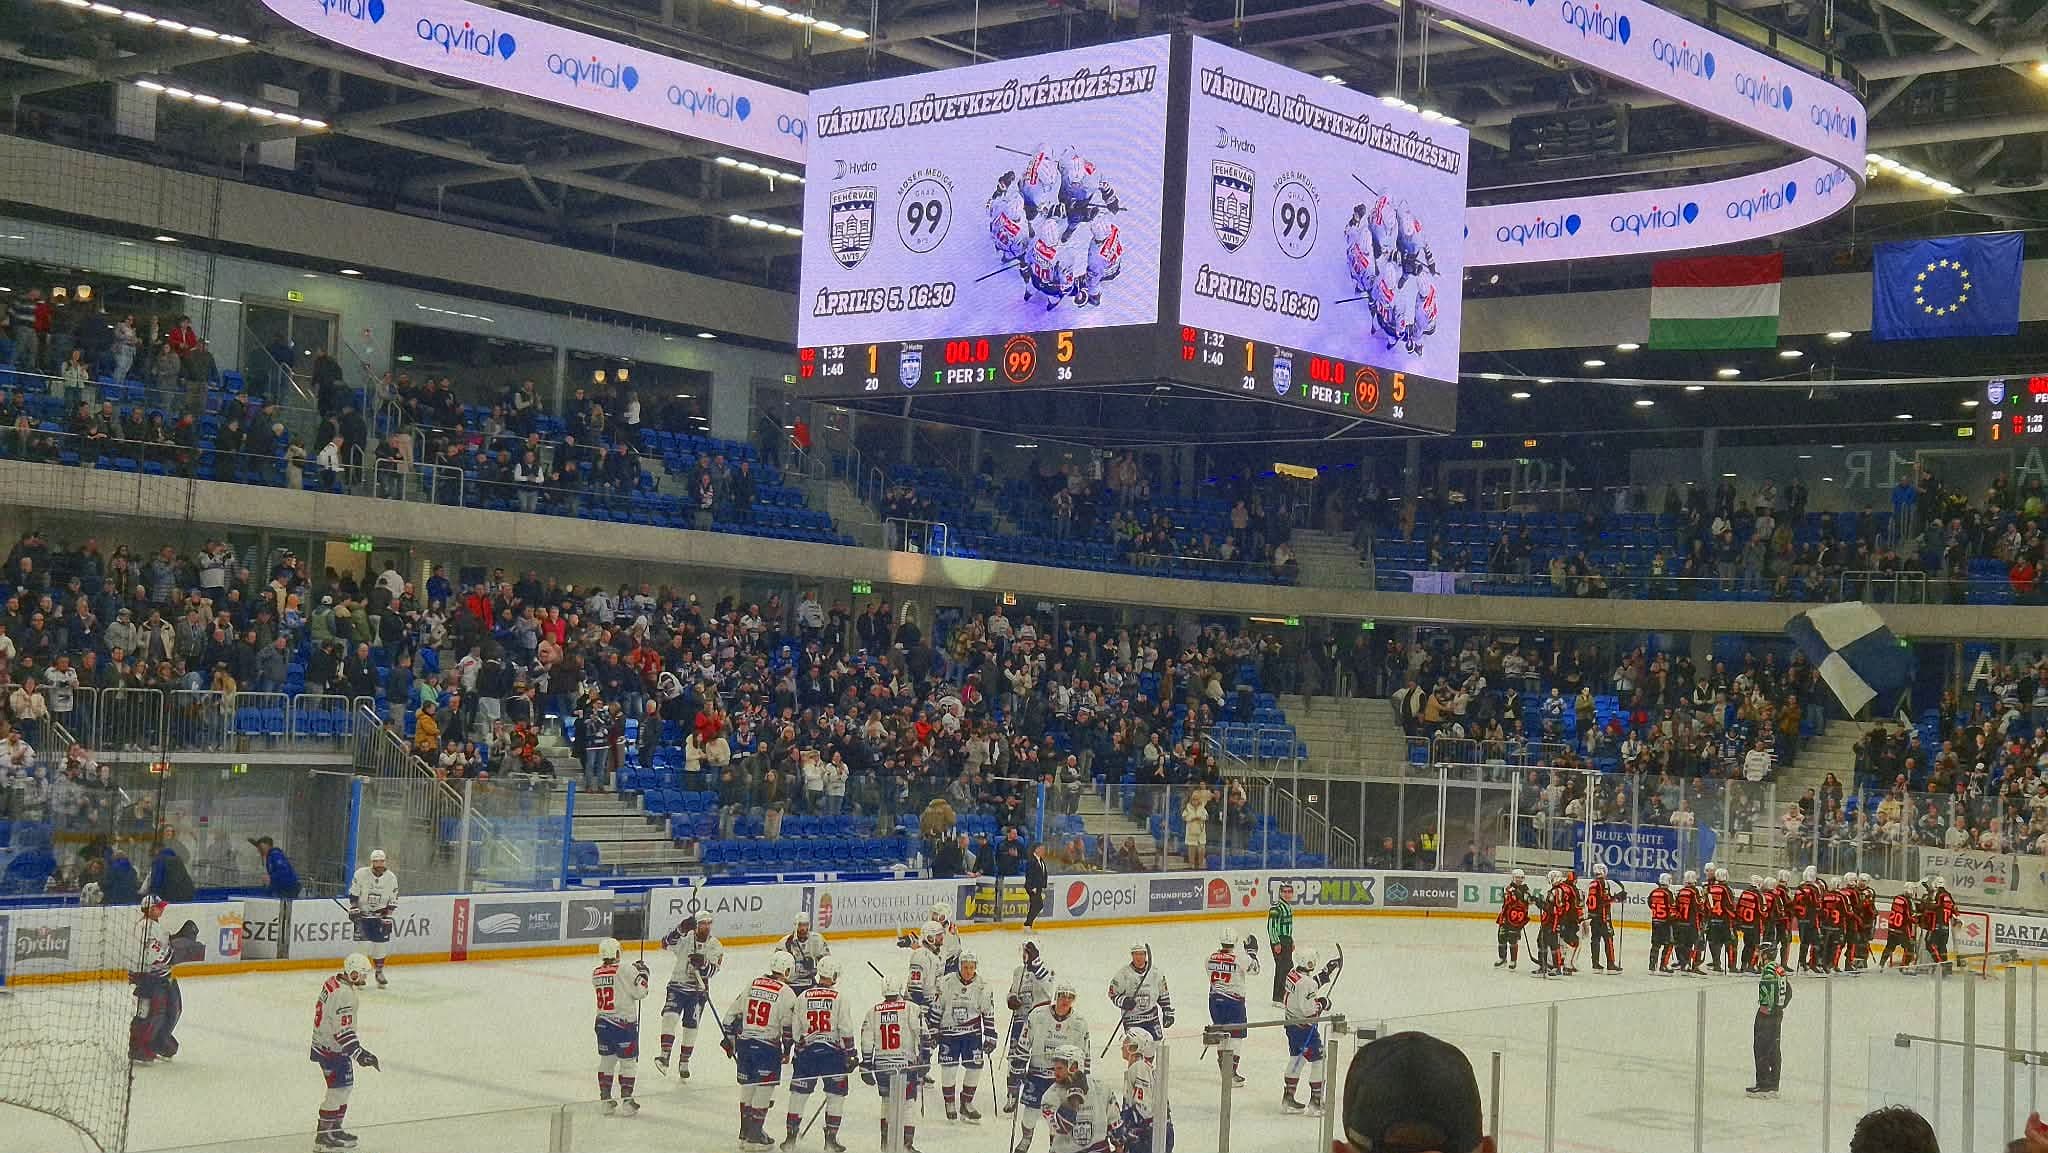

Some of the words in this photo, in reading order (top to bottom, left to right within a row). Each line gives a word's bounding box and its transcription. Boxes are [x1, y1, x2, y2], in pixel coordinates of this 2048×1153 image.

[1562, 0, 1617, 42] aqvital
[417, 18, 496, 56] aqvital
[547, 54, 620, 88] aqvital
[1652, 38, 1703, 77] aqvital
[667, 85, 734, 120] aqvital
[818, 103, 889, 137] VÁRUNK
[889, 104, 906, 128] A
[910, 79, 1017, 125] KÖVETKEZŐ
[1017, 65, 1157, 110] MÉRKŐZÉSEN!
[1735, 72, 1781, 109] aqvital
[1201, 67, 1266, 112] VÁRUNK
[1267, 91, 1281, 115] A
[1283, 94, 1370, 145] KÖVETKEZŐ
[1369, 122, 1461, 175] MÉRKŐZÉSEN!
[1811, 105, 1851, 138] aqvital
[1230, 136, 1256, 153] Hydro
[850, 160, 877, 175] Hydro
[897, 170, 923, 196] MOSER
[925, 168, 955, 192] MEDICAL
[1726, 183, 1785, 221] aqvital
[907, 200, 943, 236] 99
[1281, 203, 1311, 240] 99
[1496, 215, 1563, 246] aqvital
[1611, 203, 1681, 237] aqvital
[813, 287, 886, 317] ÁPRILIS
[887, 287, 905, 312] 5.
[908, 282, 956, 310] 16:30
[1195, 264, 1262, 308] ÁPRILIS
[1263, 285, 1277, 313] 5.
[1280, 287, 1321, 320] 16:30
[946, 339, 989, 364] 00.0
[1057, 331, 1073, 362] 5
[1204, 331, 1225, 348] 1:32
[823, 347, 845, 360] 1:32
[868, 345, 878, 374] 1
[1009, 352, 1032, 373] 99
[1203, 349, 1224, 366] 1:40
[1245, 341, 1254, 372] 1
[822, 363, 844, 376] 1:40
[934, 371, 942, 384] T
[947, 369, 973, 384] PER
[976, 367, 985, 382] 3
[988, 367, 996, 381] T
[1057, 367, 1072, 380] 36
[1243, 375, 1255, 390] 20
[1310, 357, 1346, 384] 00.0
[865, 378, 879, 391] 20
[1301, 384, 1308, 397] T
[1311, 385, 1333, 403] PER
[1334, 391, 1341, 404] 3
[1343, 393, 1350, 405] T
[1360, 382, 1375, 402] 99
[1393, 373, 1405, 401] 5
[1392, 406, 1404, 418] 36
[1596, 830, 1664, 845] BLUE-WHITE
[1091, 885, 1137, 910] pepsi
[1150, 891, 1193, 900] GRUNDFOS
[1269, 877, 1375, 905] TPPMIX
[1412, 889, 1456, 898] ARCONIC
[529, 912, 551, 921] MET
[669, 896, 763, 915] ROLAND
[746, 999, 771, 1027] 59
[806, 1010, 832, 1034] 36
[880, 1023, 901, 1050] 16
